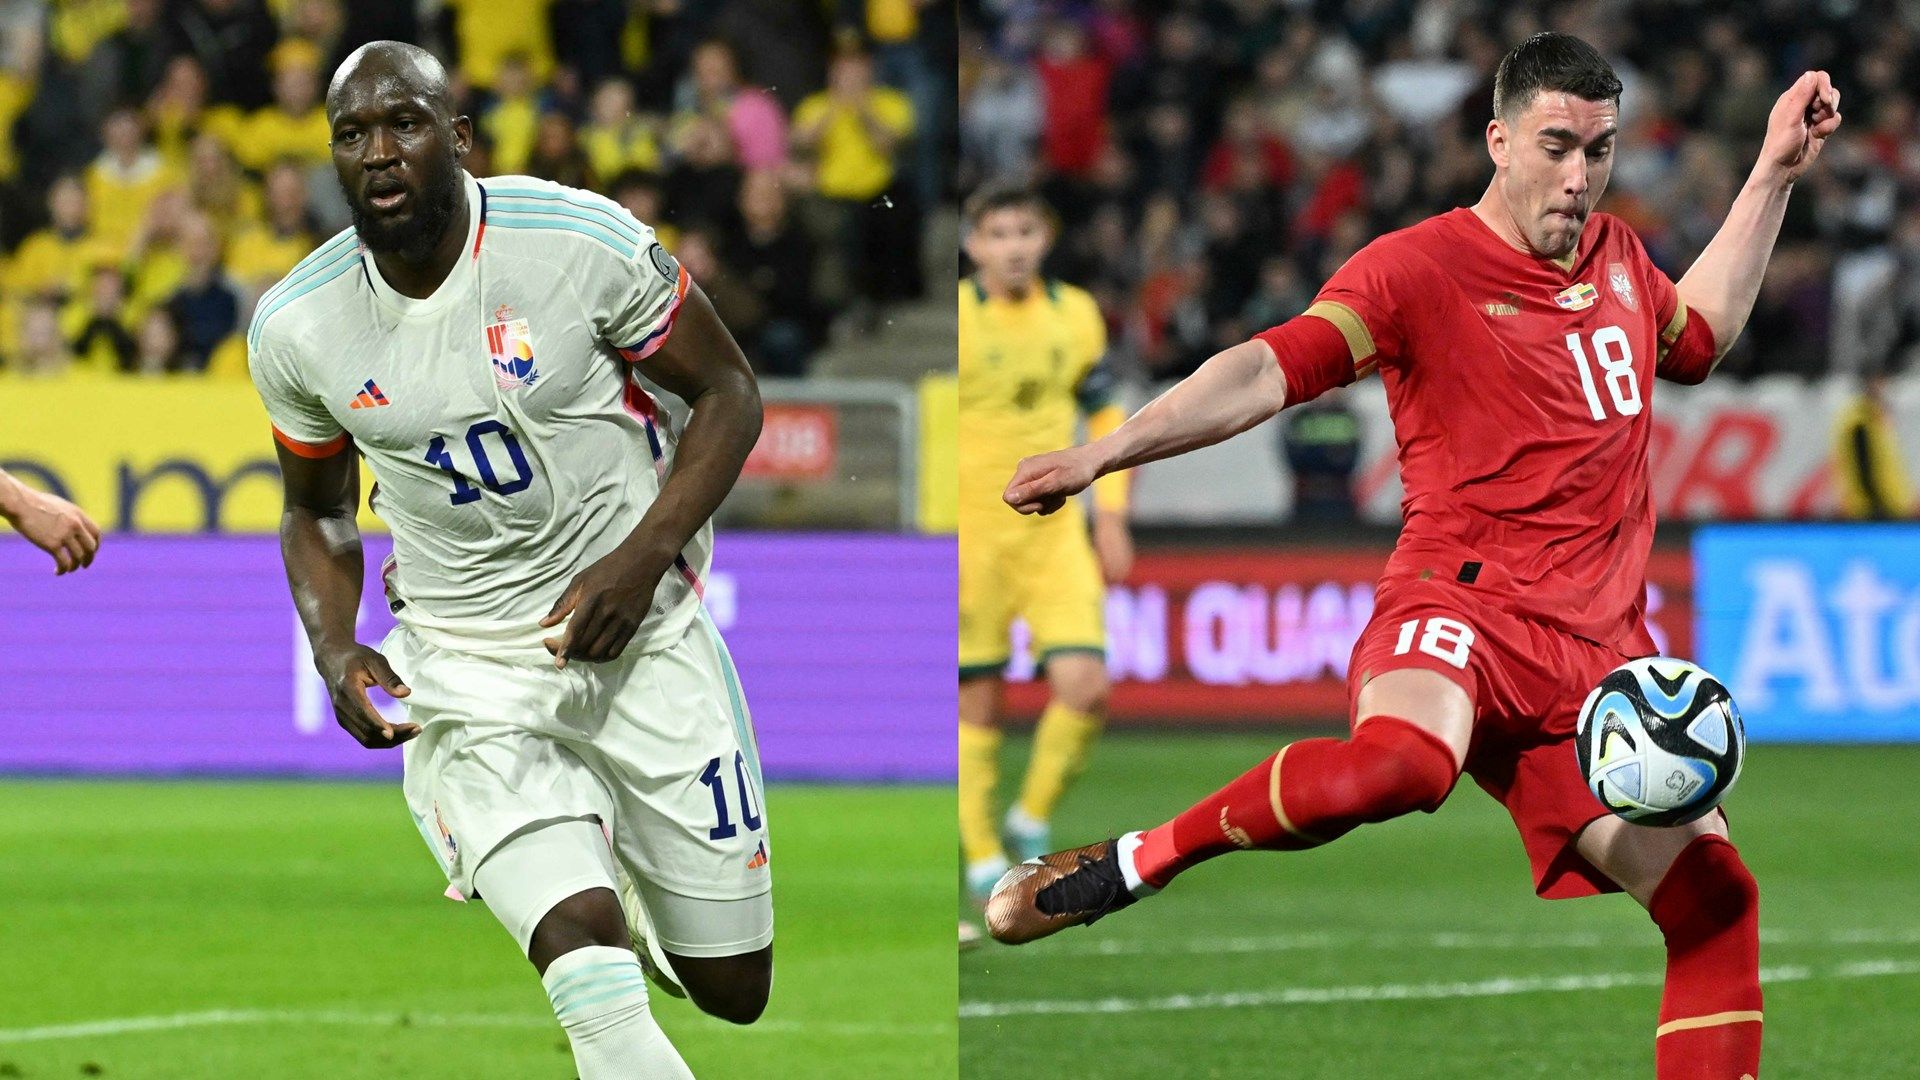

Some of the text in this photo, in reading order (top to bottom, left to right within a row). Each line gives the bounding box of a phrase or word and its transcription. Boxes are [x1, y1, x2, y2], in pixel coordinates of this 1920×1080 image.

[1565, 325, 1644, 421] 18
[424, 419, 534, 506] 10
[1393, 616, 1476, 670] 18
[699, 749, 762, 841] 10
